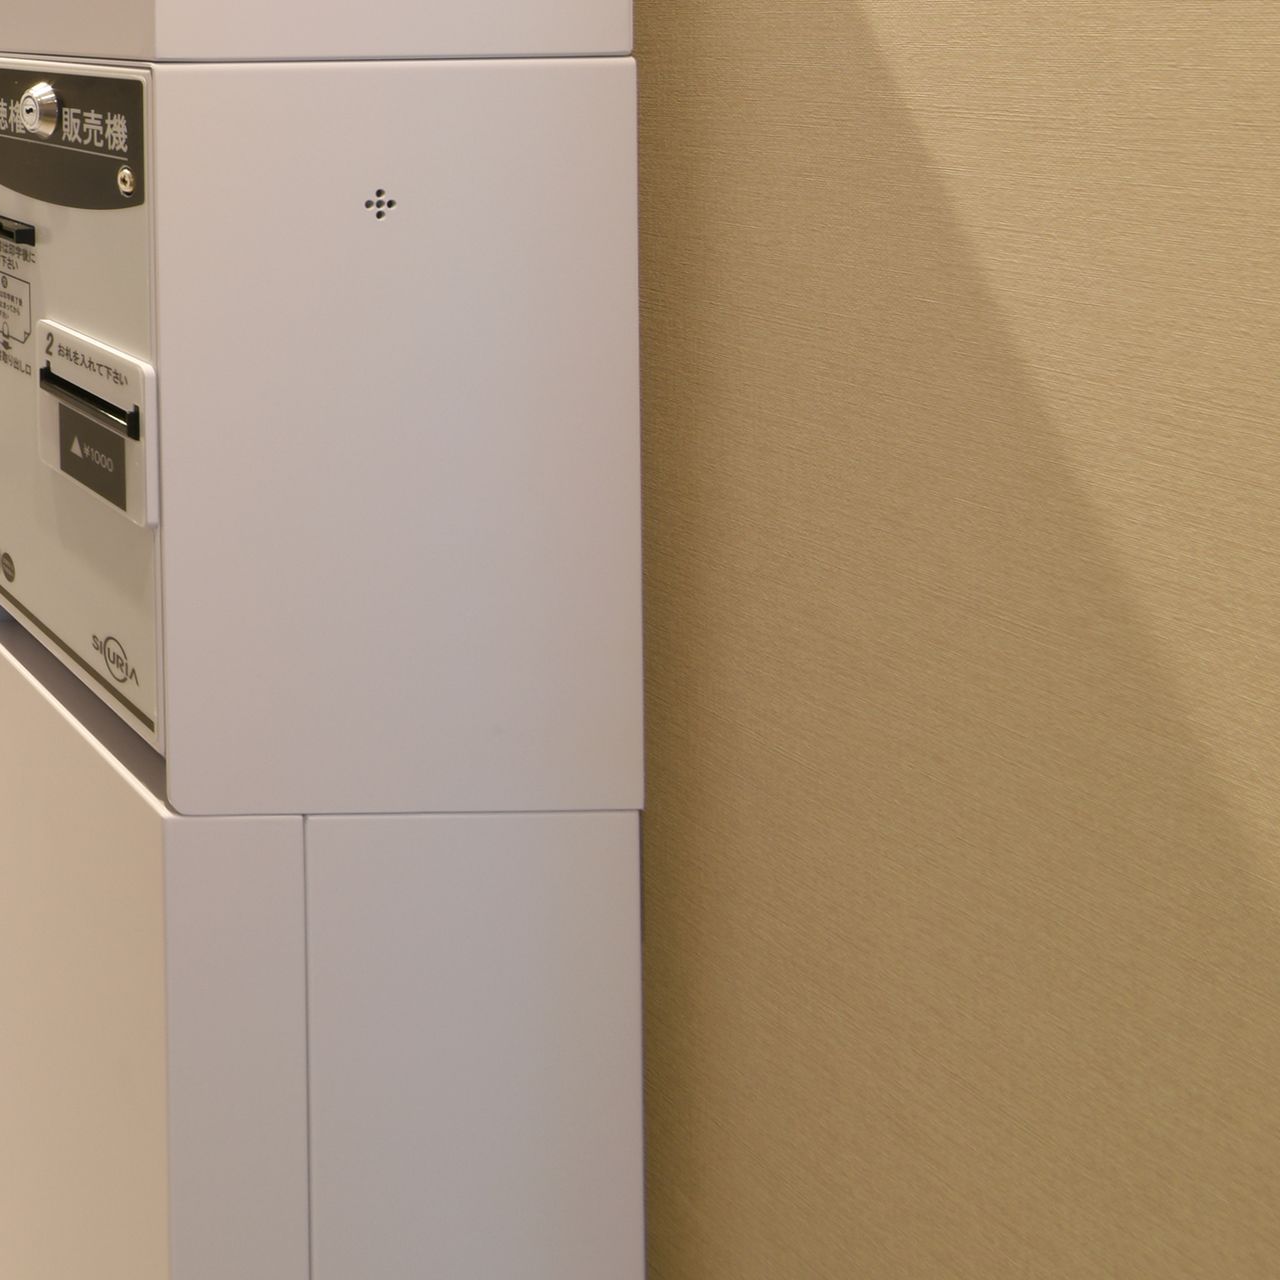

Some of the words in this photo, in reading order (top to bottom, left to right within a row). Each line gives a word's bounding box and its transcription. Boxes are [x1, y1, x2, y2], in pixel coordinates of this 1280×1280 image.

[61, 106, 128, 153] 販売機
[45, 332, 54, 356] 2
[57, 342, 129, 386] お札を入れて下さい
[82, 443, 114, 473] ¥1000
